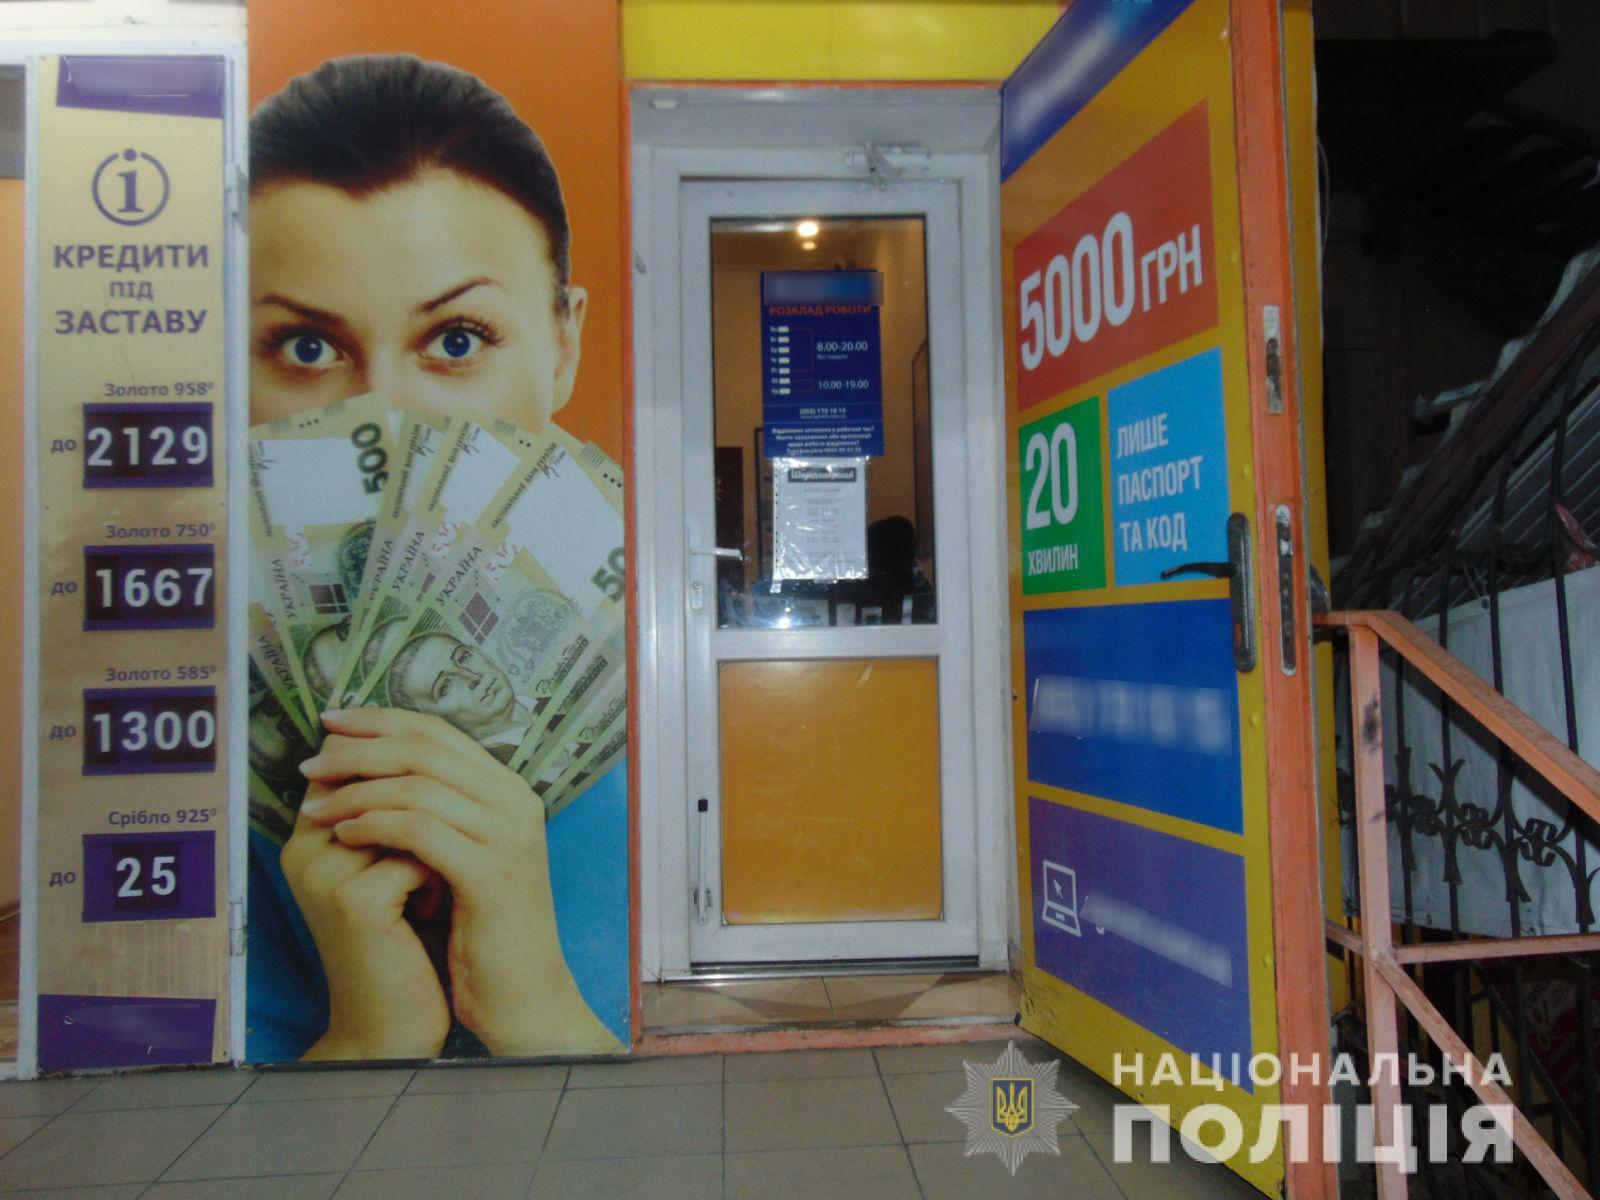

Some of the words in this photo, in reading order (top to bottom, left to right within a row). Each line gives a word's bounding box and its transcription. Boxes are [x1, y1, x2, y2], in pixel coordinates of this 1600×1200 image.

[54, 245, 208, 273] КРЕДИТИ
[109, 281, 154, 301] ПІД
[1020, 212, 1135, 370] 5000
[1141, 224, 1203, 312] ГРН
[55, 309, 207, 335] ЗАСТАВУ
[105, 383, 169, 396] Золото
[51, 438, 77, 454] до
[87, 426, 208, 466] 2129
[1116, 413, 1169, 459] ЛИШЕ
[351, 422, 389, 495] 500
[1026, 422, 1079, 531] 20
[1118, 456, 1204, 506] ПАСПОРТ
[106, 525, 170, 538] Золото
[1121, 522, 1144, 553] ТА
[1147, 512, 1188, 552] КОД
[436, 546, 482, 606] УКРАЇНА
[1028, 543, 1079, 577] ХВИЛИН
[51, 581, 77, 596] до
[96, 568, 213, 607] 1667
[106, 668, 171, 681] Золото
[50, 725, 77, 740] до
[93, 710, 215, 752] 1300
[108, 811, 170, 827] Срібло
[49, 872, 77, 887] до
[116, 856, 176, 897] 25
